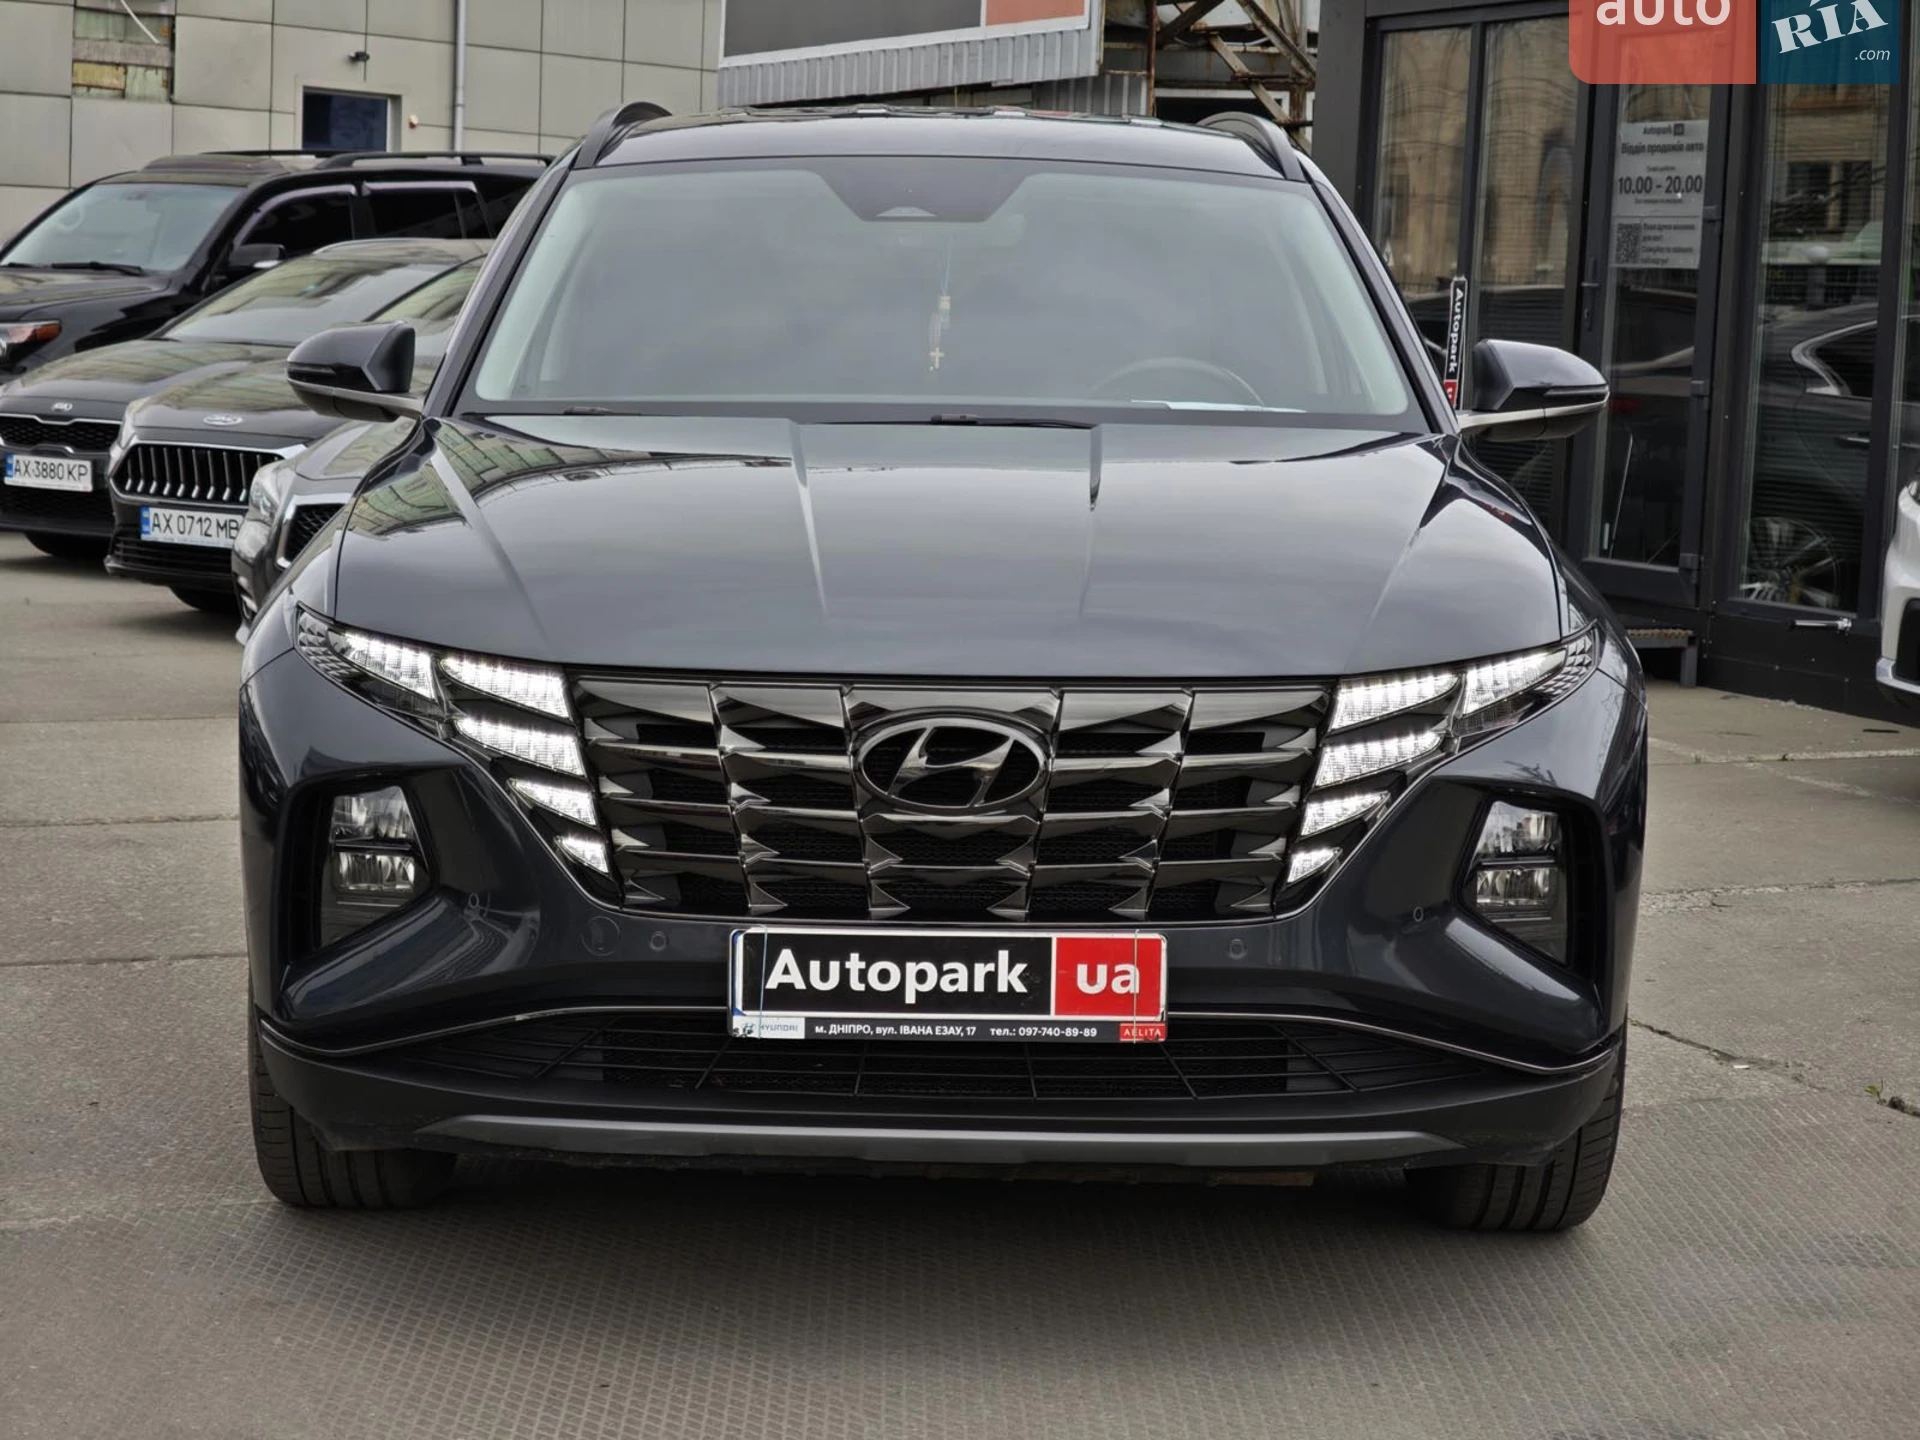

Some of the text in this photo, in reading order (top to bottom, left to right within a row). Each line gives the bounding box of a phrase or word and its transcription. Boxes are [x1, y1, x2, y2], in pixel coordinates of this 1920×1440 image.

[1618, 176, 1652, 194] 10.00
[1665, 175, 1703, 193] 20.00
[1448, 288, 1464, 373] Autopark
[14, 459, 88, 482] AX 3880 KP
[152, 512, 173, 534] AX
[177, 515, 212, 537] 0712
[765, 948, 1028, 1004] Autopark
[1076, 962, 1141, 995] ua
[815, 1025, 827, 1034] м.
[828, 1023, 873, 1036] ДНІПРО,
[876, 1026, 897, 1037] вул.
[900, 1025, 933, 1035] ІВАНА
[966, 1026, 976, 1036] 17
[990, 1027, 1016, 1036] тел.:
[1018, 1027, 1098, 1037] 097-740-89-89
